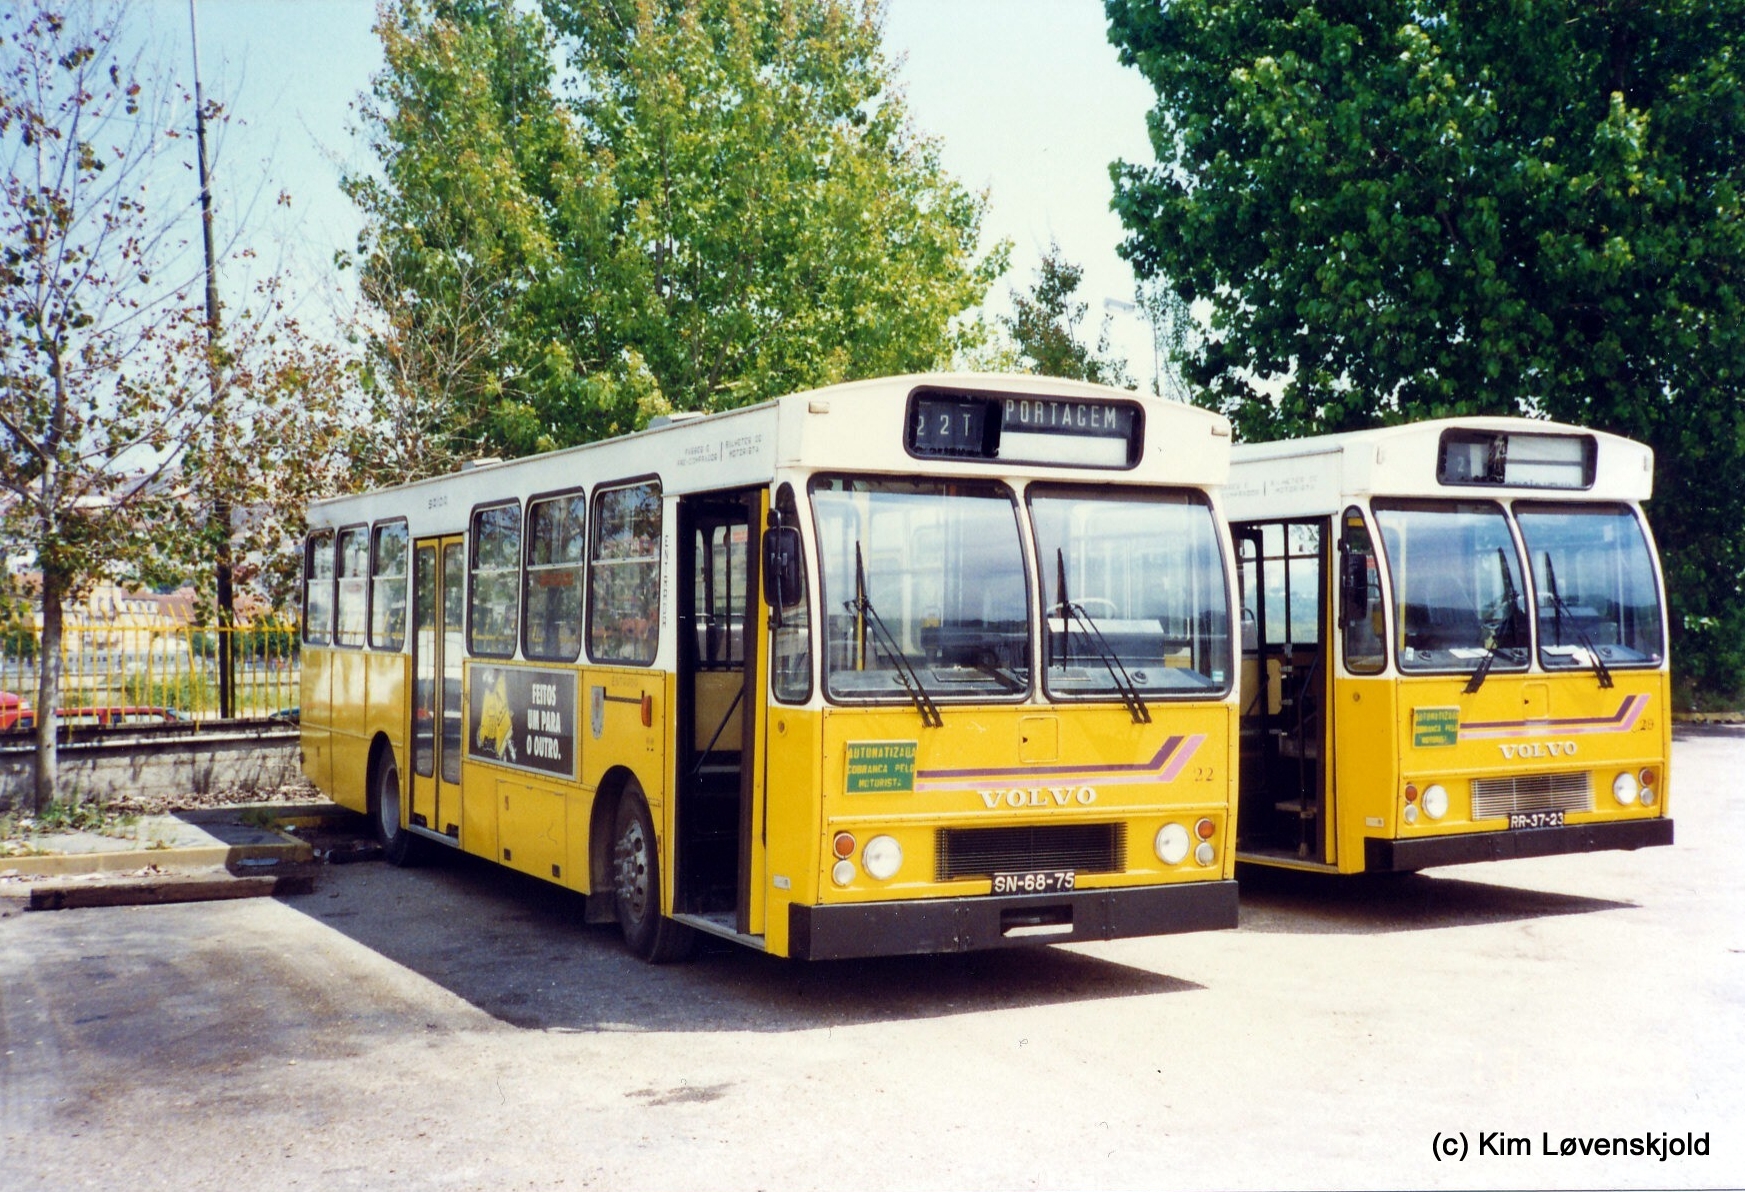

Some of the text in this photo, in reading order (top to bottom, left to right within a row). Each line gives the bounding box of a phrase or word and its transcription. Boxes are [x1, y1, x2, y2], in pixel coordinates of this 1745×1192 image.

[1005, 399, 1117, 429] PORTAGEM
[532, 684, 557, 707] FEITOS
[527, 710, 561, 733] UM PARA
[526, 735, 561, 760] O OUTRO.
[1499, 740, 1578, 760] VOLVO
[977, 785, 1097, 809] VOLVO
[1510, 811, 1565, 829] RR-37-23
[993, 871, 1076, 893] SN-68-75
